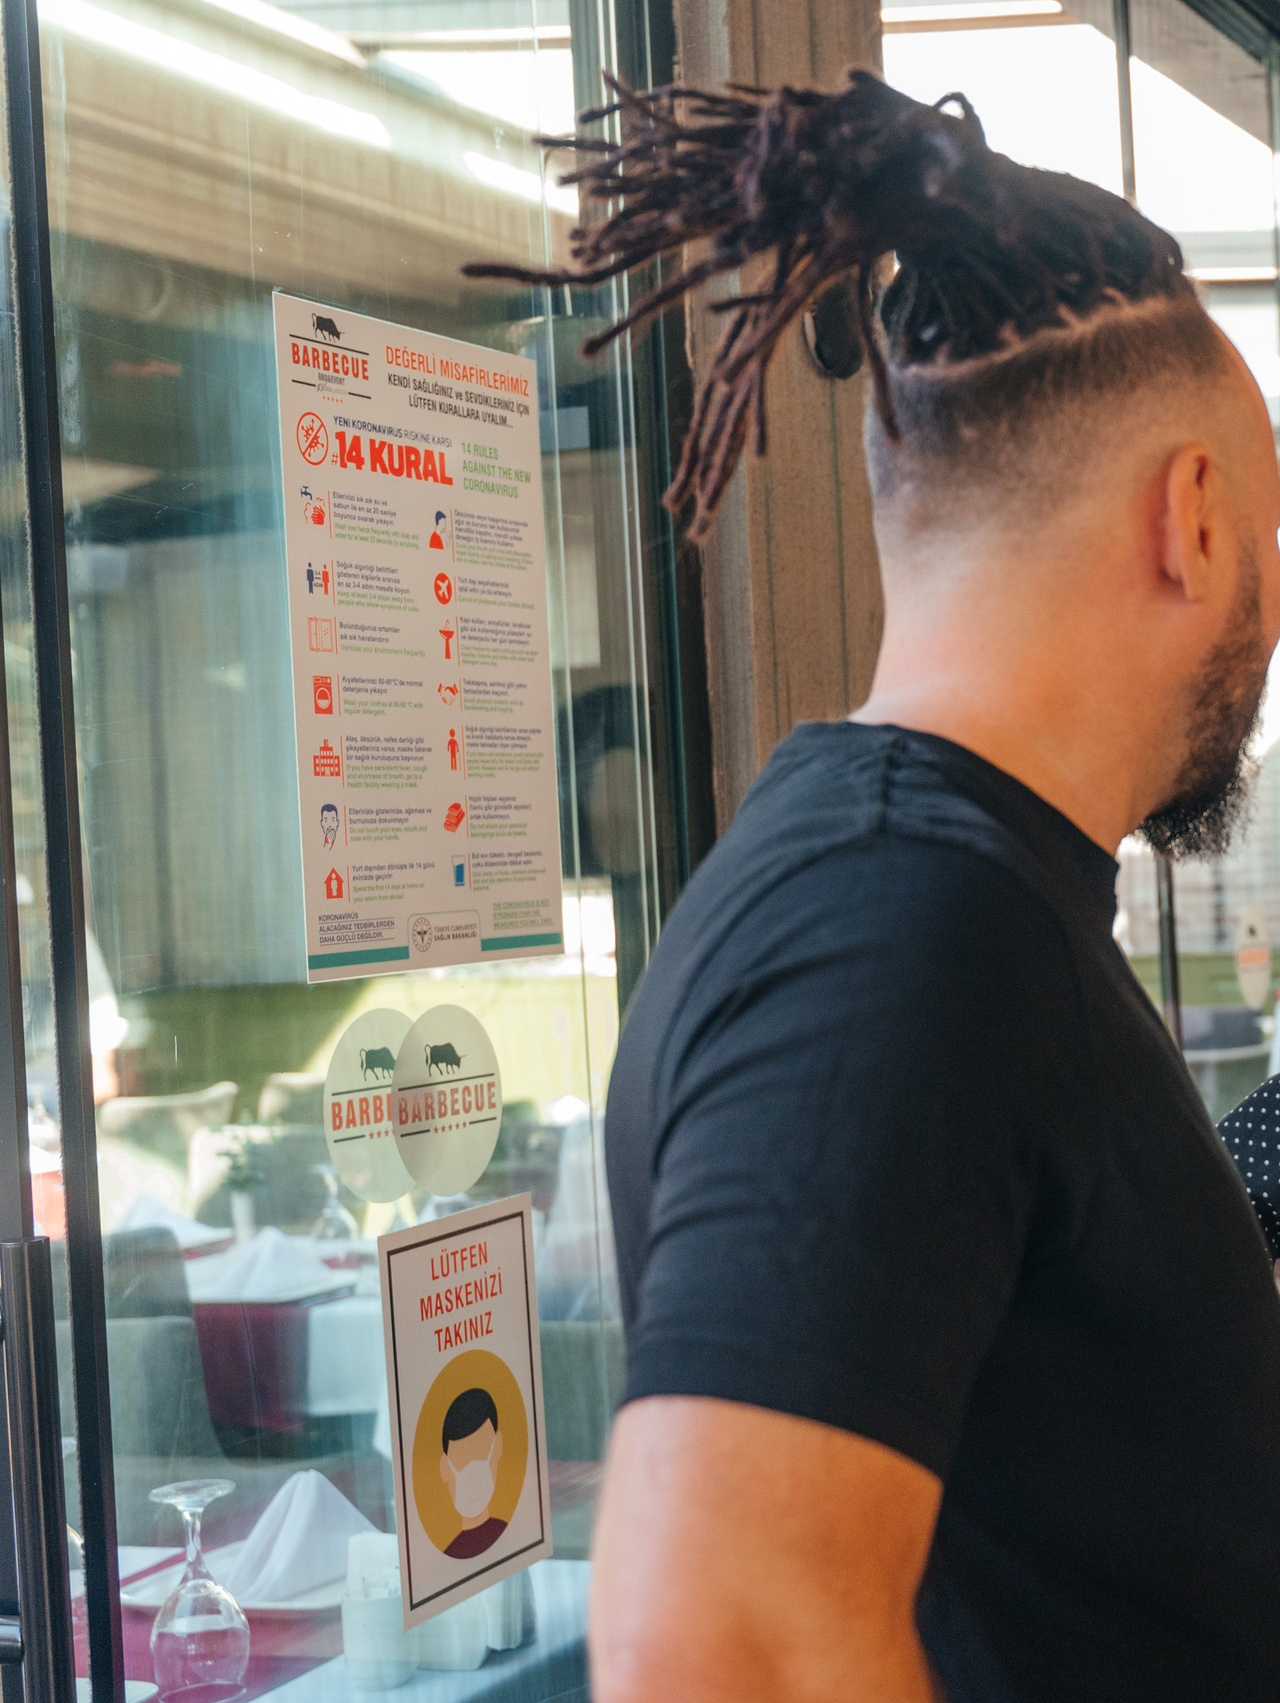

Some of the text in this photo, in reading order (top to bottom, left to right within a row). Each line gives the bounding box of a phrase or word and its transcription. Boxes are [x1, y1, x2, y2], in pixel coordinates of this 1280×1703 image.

[291, 342, 368, 380] BARBECUE
[385, 341, 529, 397] DEĞERLİ MİSAFİRLERİMİZ
[387, 369, 410, 391] KENDİ
[412, 375, 452, 401] SAĞLIĞINIZ
[455, 385, 462, 403] ve
[464, 388, 514, 415] SEVDİKLERİNİZ
[408, 392, 436, 412] LÜTFEN
[438, 398, 479, 421] KURALLARA
[329, 428, 453, 487] #14 KURAL
[461, 441, 498, 460] 14 RULES
[462, 459, 531, 484] AGAINST THE NEW
[463, 476, 518, 499] CORONAVIRUS
[398, 1082, 497, 1126] BARBECUE
[431, 1241, 488, 1281] LÜTFEN
[420, 1266, 502, 1322] MASKENİZİ
[434, 1310, 493, 1352] TAKINIZ
